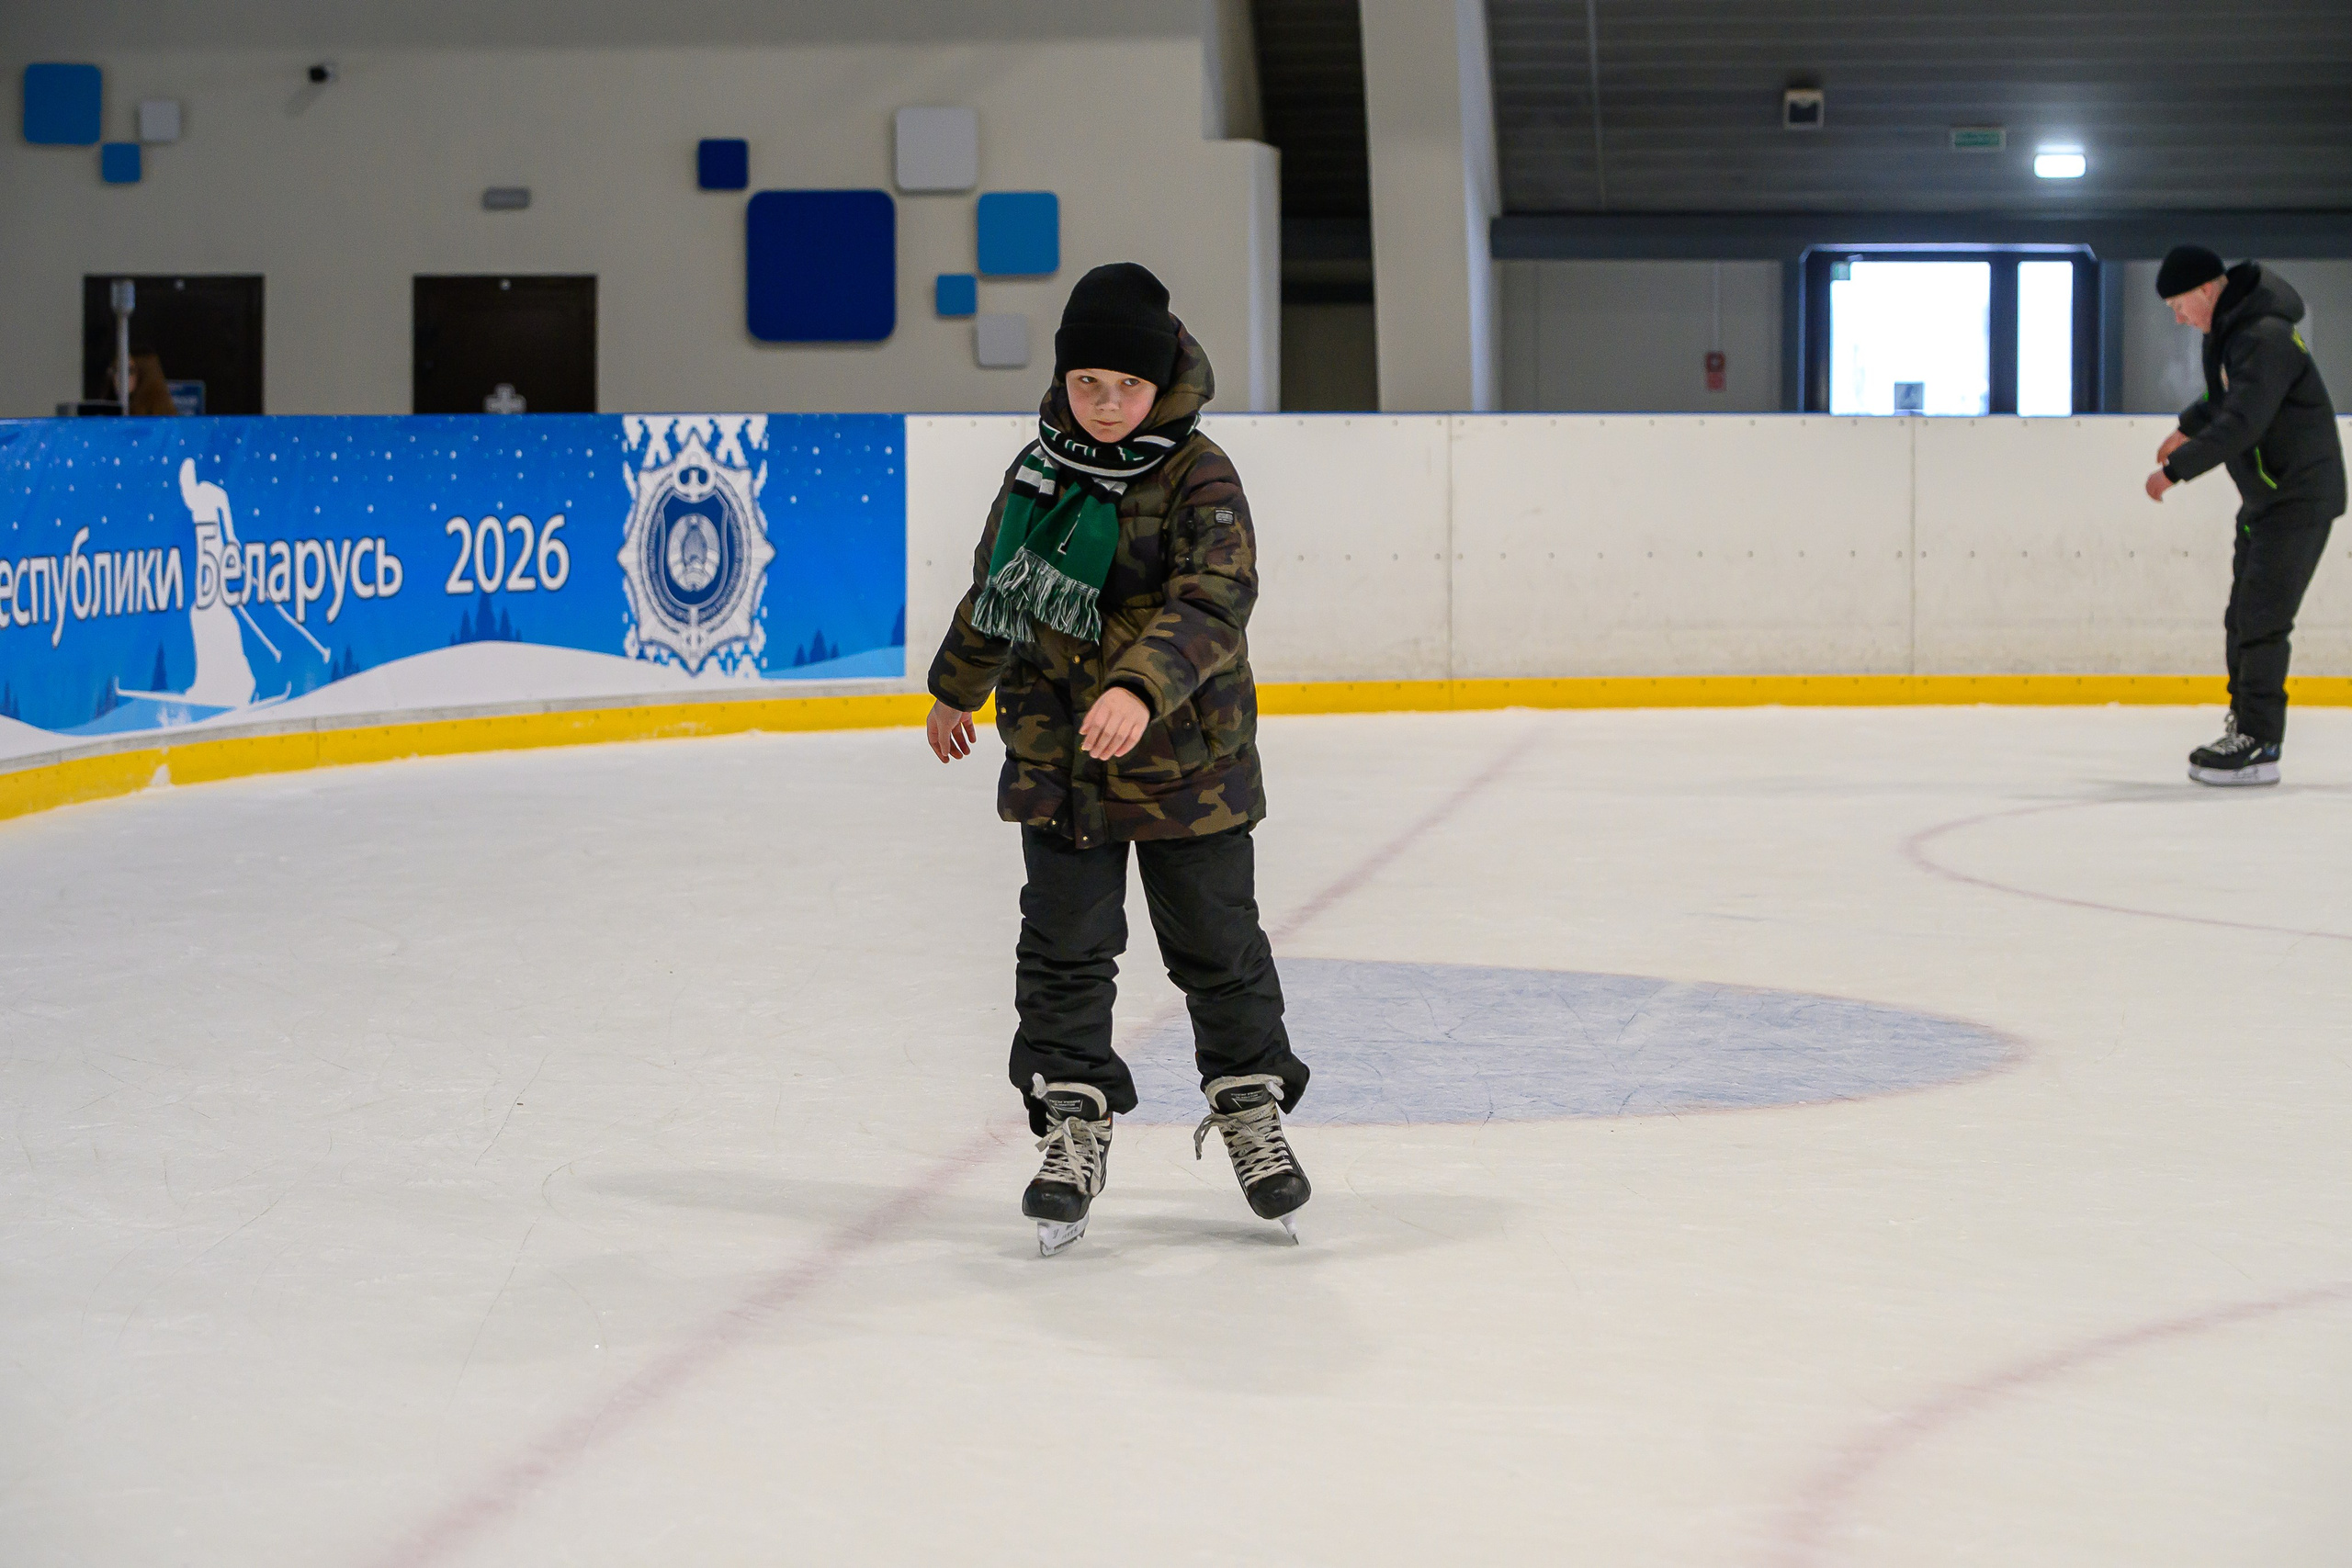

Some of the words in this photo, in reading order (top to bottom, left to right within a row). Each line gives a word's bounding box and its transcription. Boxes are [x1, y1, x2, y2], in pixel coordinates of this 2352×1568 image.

[0, 525, 184, 649] еспублики
[195, 522, 403, 623] Беларусь
[445, 513, 571, 595] 2026
